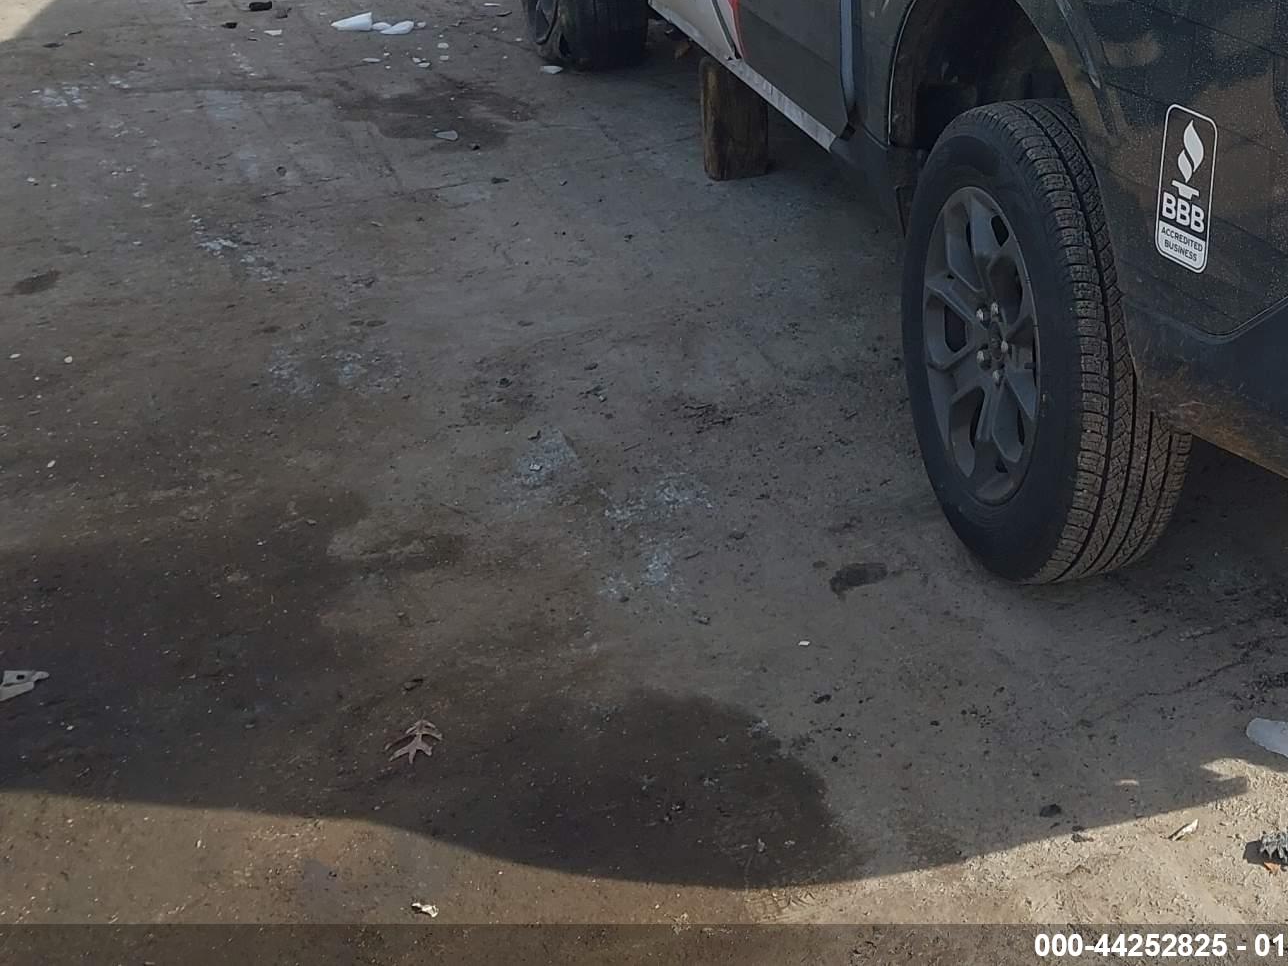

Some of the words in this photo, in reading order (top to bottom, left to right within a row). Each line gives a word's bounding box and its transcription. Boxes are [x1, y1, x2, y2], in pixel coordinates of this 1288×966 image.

[1161, 191, 1205, 234] BBB
[1161, 226, 1204, 252] ACCREDITED
[1164, 238, 1198, 262] BUSINESS
